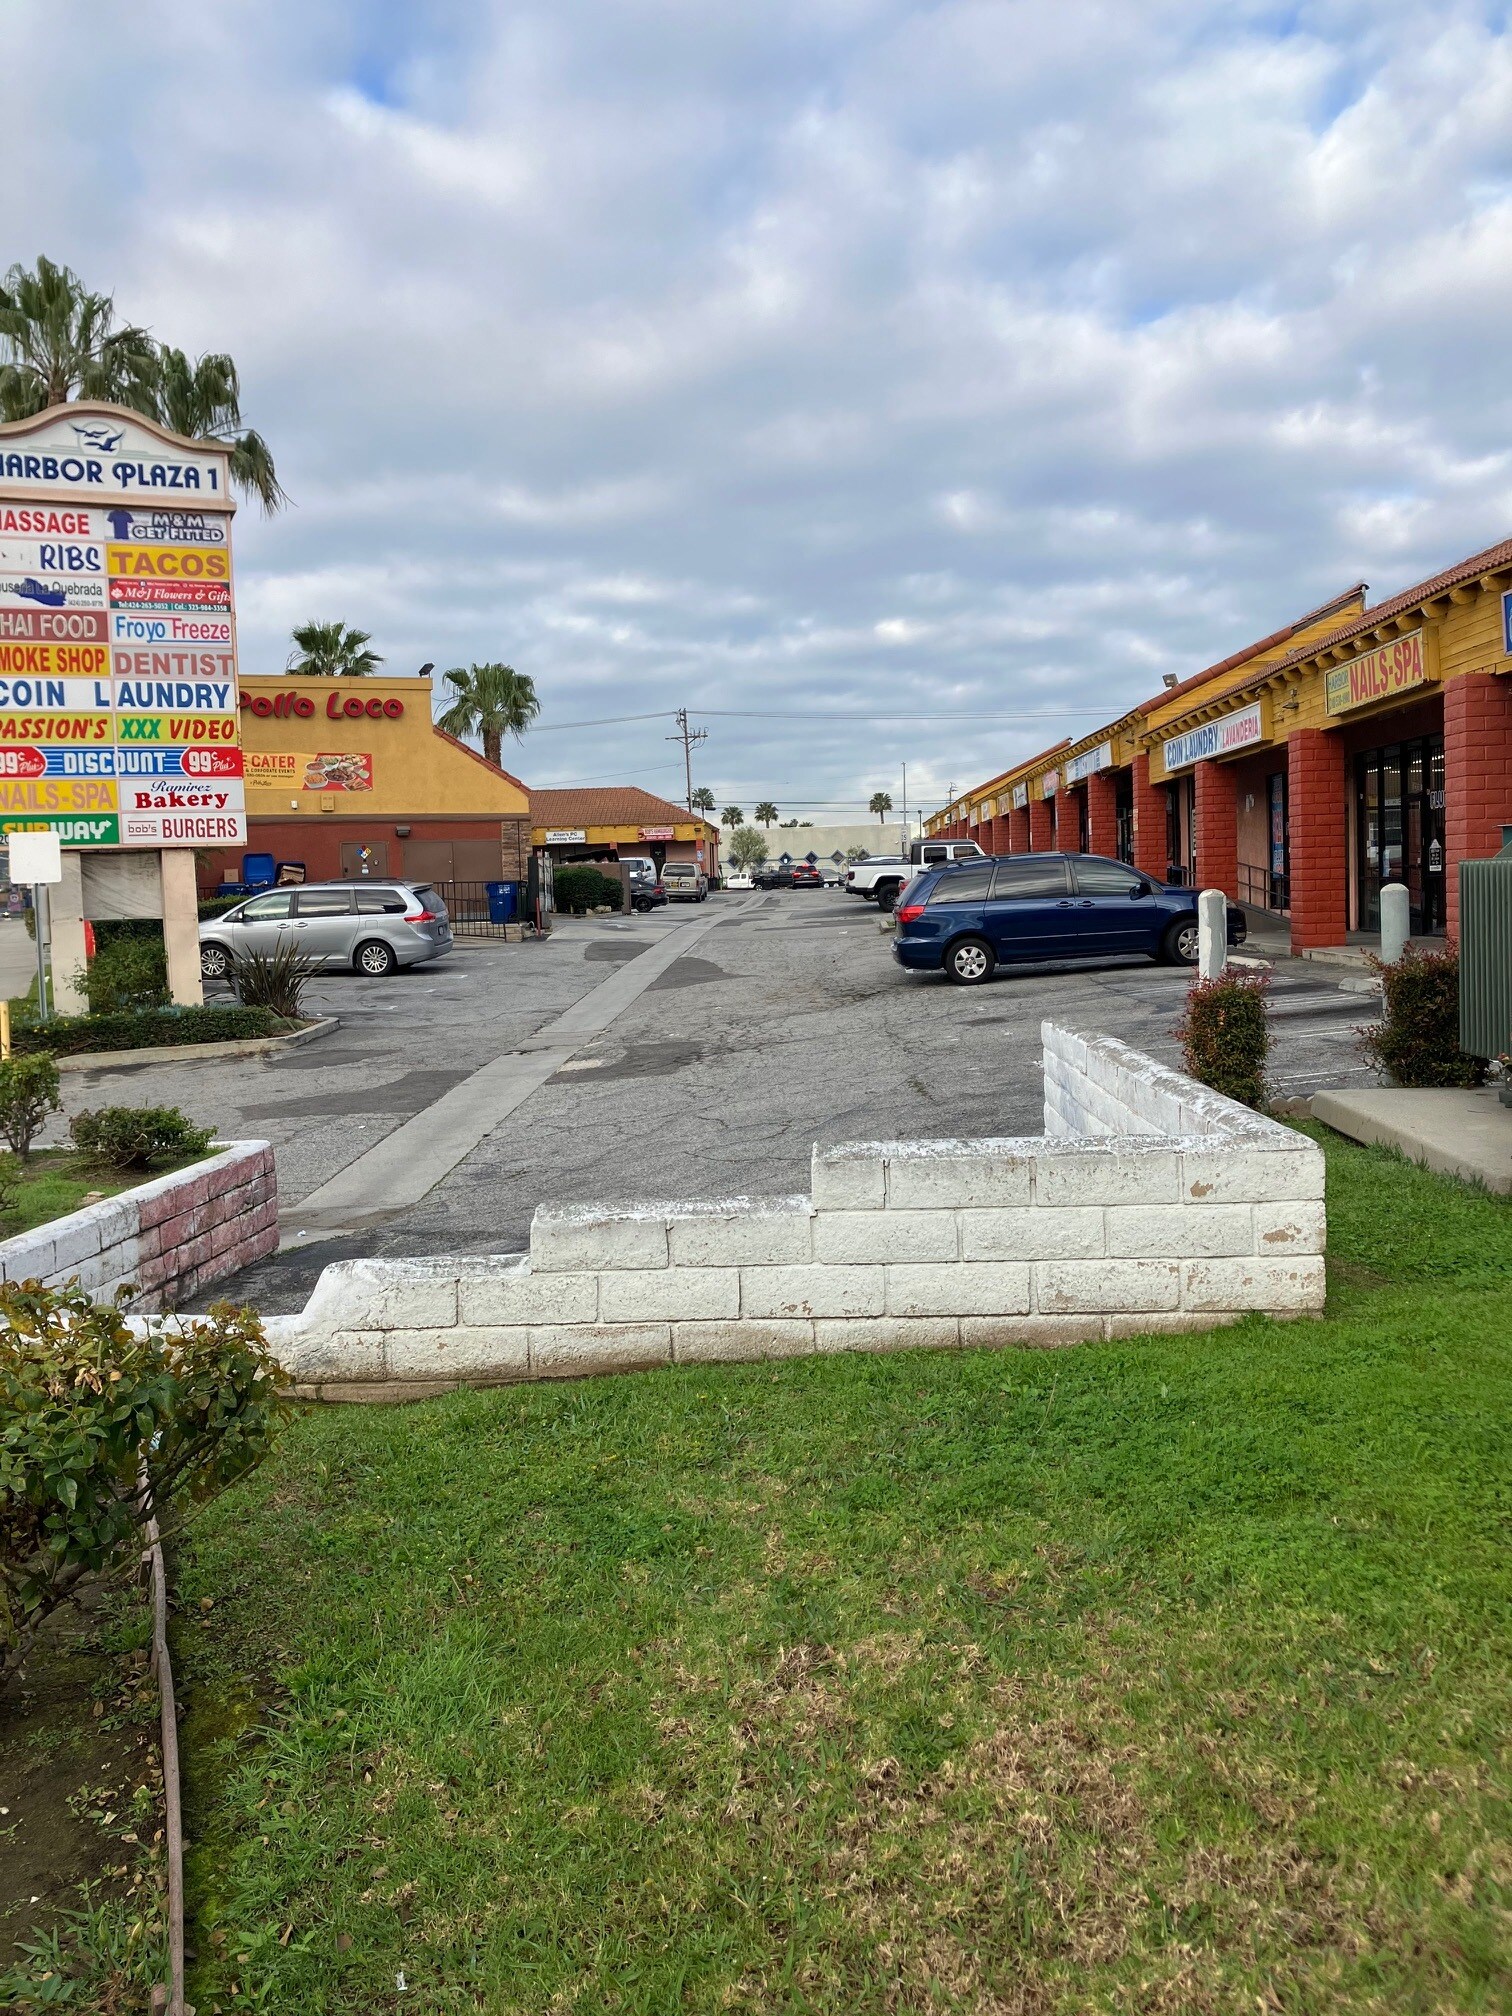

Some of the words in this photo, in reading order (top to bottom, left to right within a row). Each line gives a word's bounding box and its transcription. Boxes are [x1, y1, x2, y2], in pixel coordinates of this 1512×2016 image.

[0, 453, 103, 484] ARBOR
[112, 461, 200, 489] PLAZA
[207, 467, 218, 490] 1
[0, 510, 90, 535] ASSAGE
[132, 525, 166, 539] GET
[169, 527, 224, 541] FITTED
[39, 544, 101, 571] RIBS
[111, 551, 226, 577] TACOS
[52, 581, 103, 595] Quebrada
[125, 587, 152, 600] M&J
[154, 587, 192, 600] Flowers
[195, 589, 206, 600] &
[41, 614, 98, 639] FOOD
[116, 615, 166, 644] Froyo
[172, 617, 231, 640] Freeze
[56, 648, 106, 674] SHOP
[114, 652, 234, 676] DENTIST
[1350, 637, 1422, 703] NAILS-SPA
[326, 691, 405, 719] Loco
[0, 718, 108, 740] ASSION'S
[120, 718, 162, 740] XXX
[169, 718, 235, 740] VIDEO
[1167, 738, 1183, 768] COIN
[1184, 724, 1219, 762] LAUNDRY
[1222, 715, 1259, 749] LAVANDERIA
[64, 751, 167, 775] DISCOUNT
[251, 755, 296, 769] CATER
[151, 780, 212, 793] Ramirez
[135, 791, 229, 809] Bakery
[128, 821, 158, 834] bob's
[162, 817, 238, 839] BURGERS
